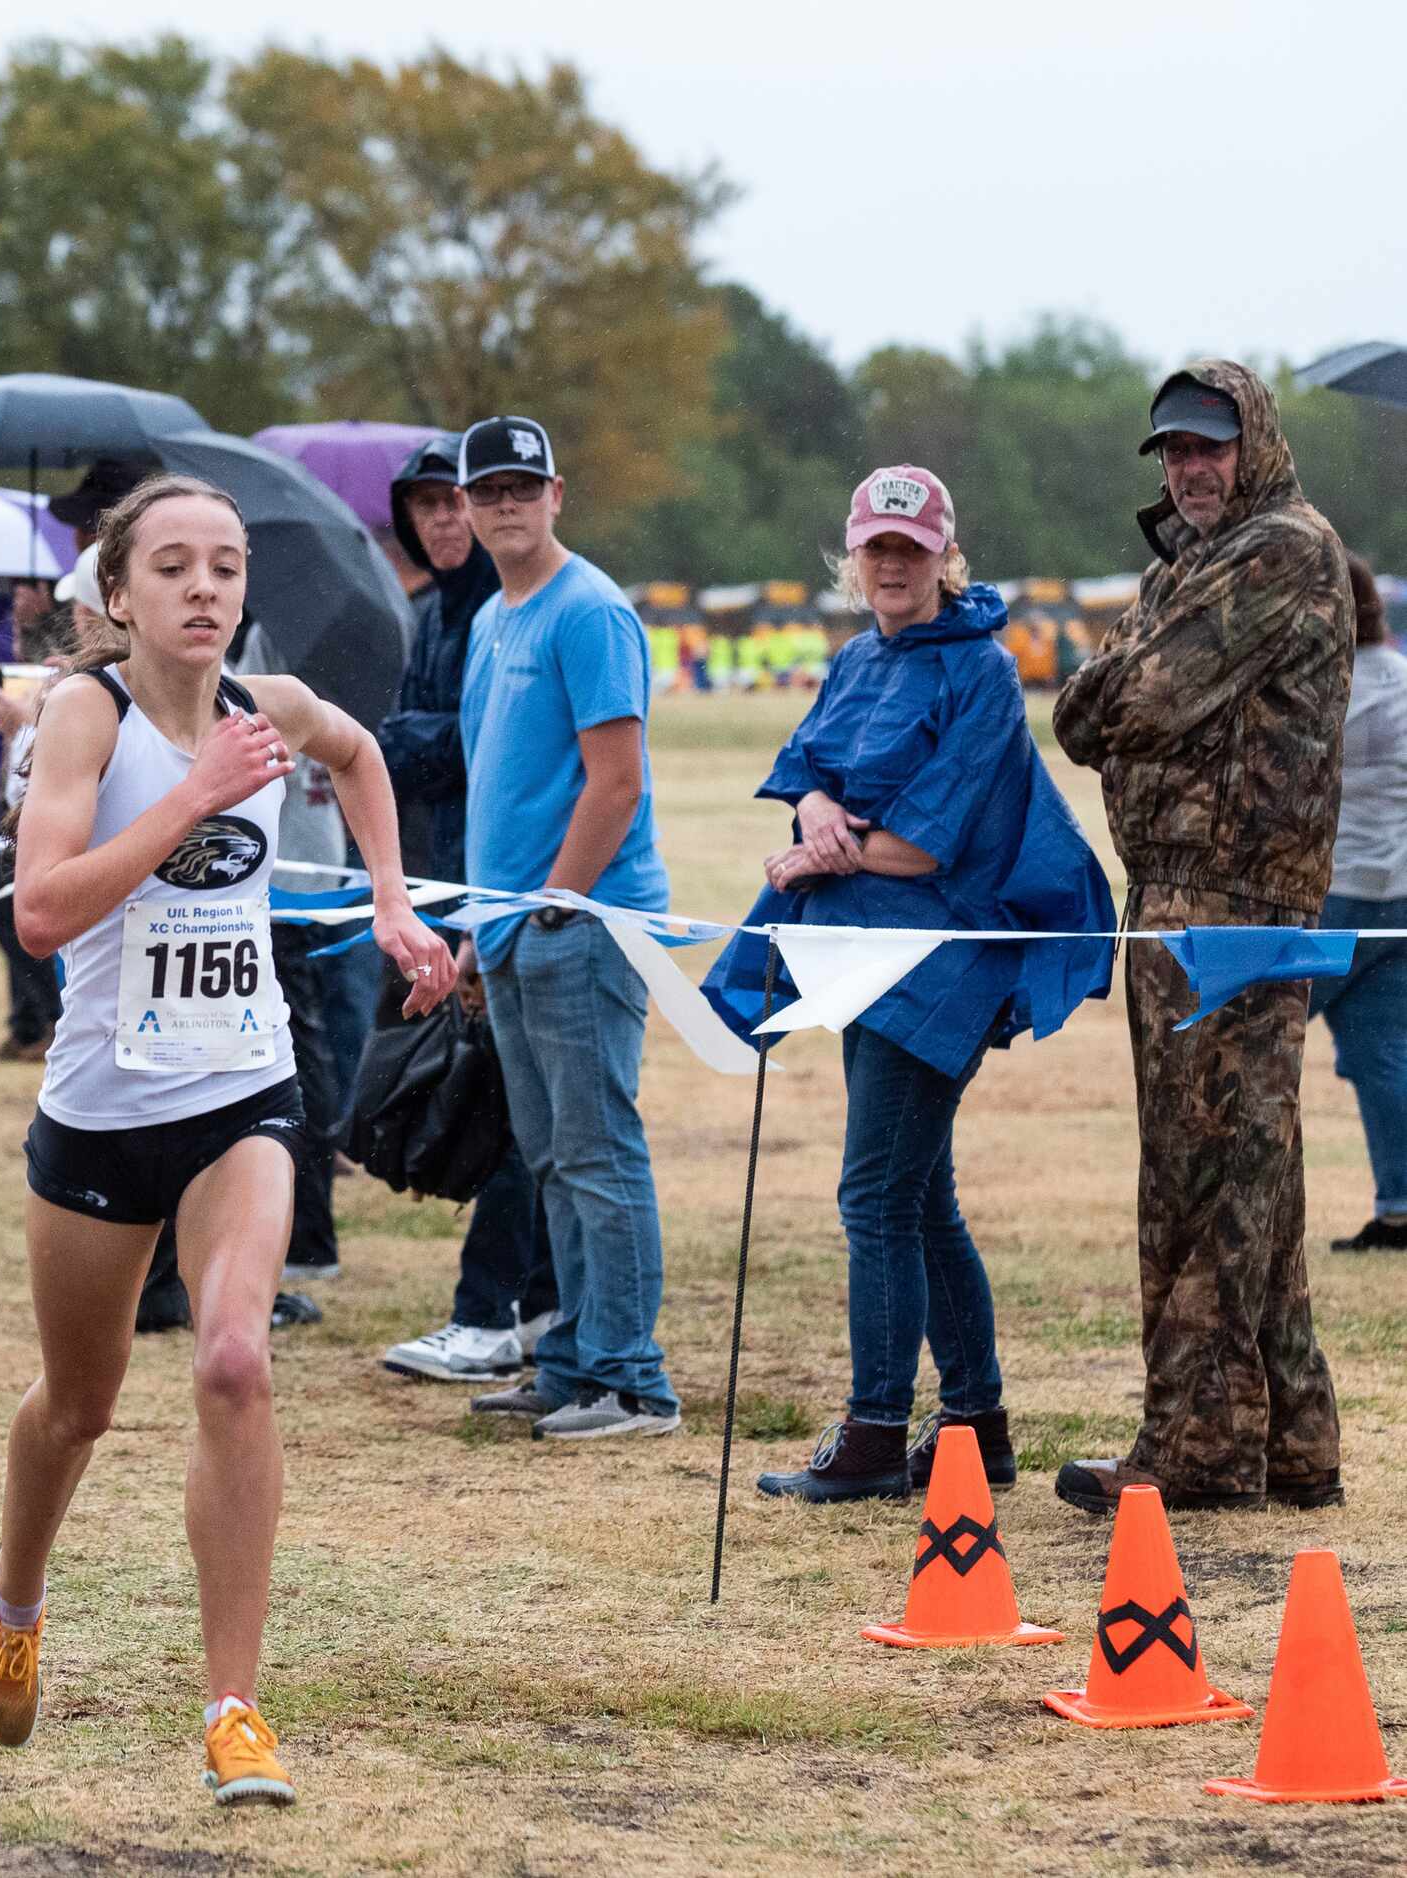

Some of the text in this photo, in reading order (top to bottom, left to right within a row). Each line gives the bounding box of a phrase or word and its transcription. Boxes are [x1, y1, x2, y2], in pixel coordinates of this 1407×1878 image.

[874, 480, 922, 495] TRACTOR
[167, 905, 243, 919] UIL Region II
[149, 920, 255, 935] XC Championship
[145, 939, 259, 999] 1156
[171, 1019, 230, 1029] ARLINGTON
